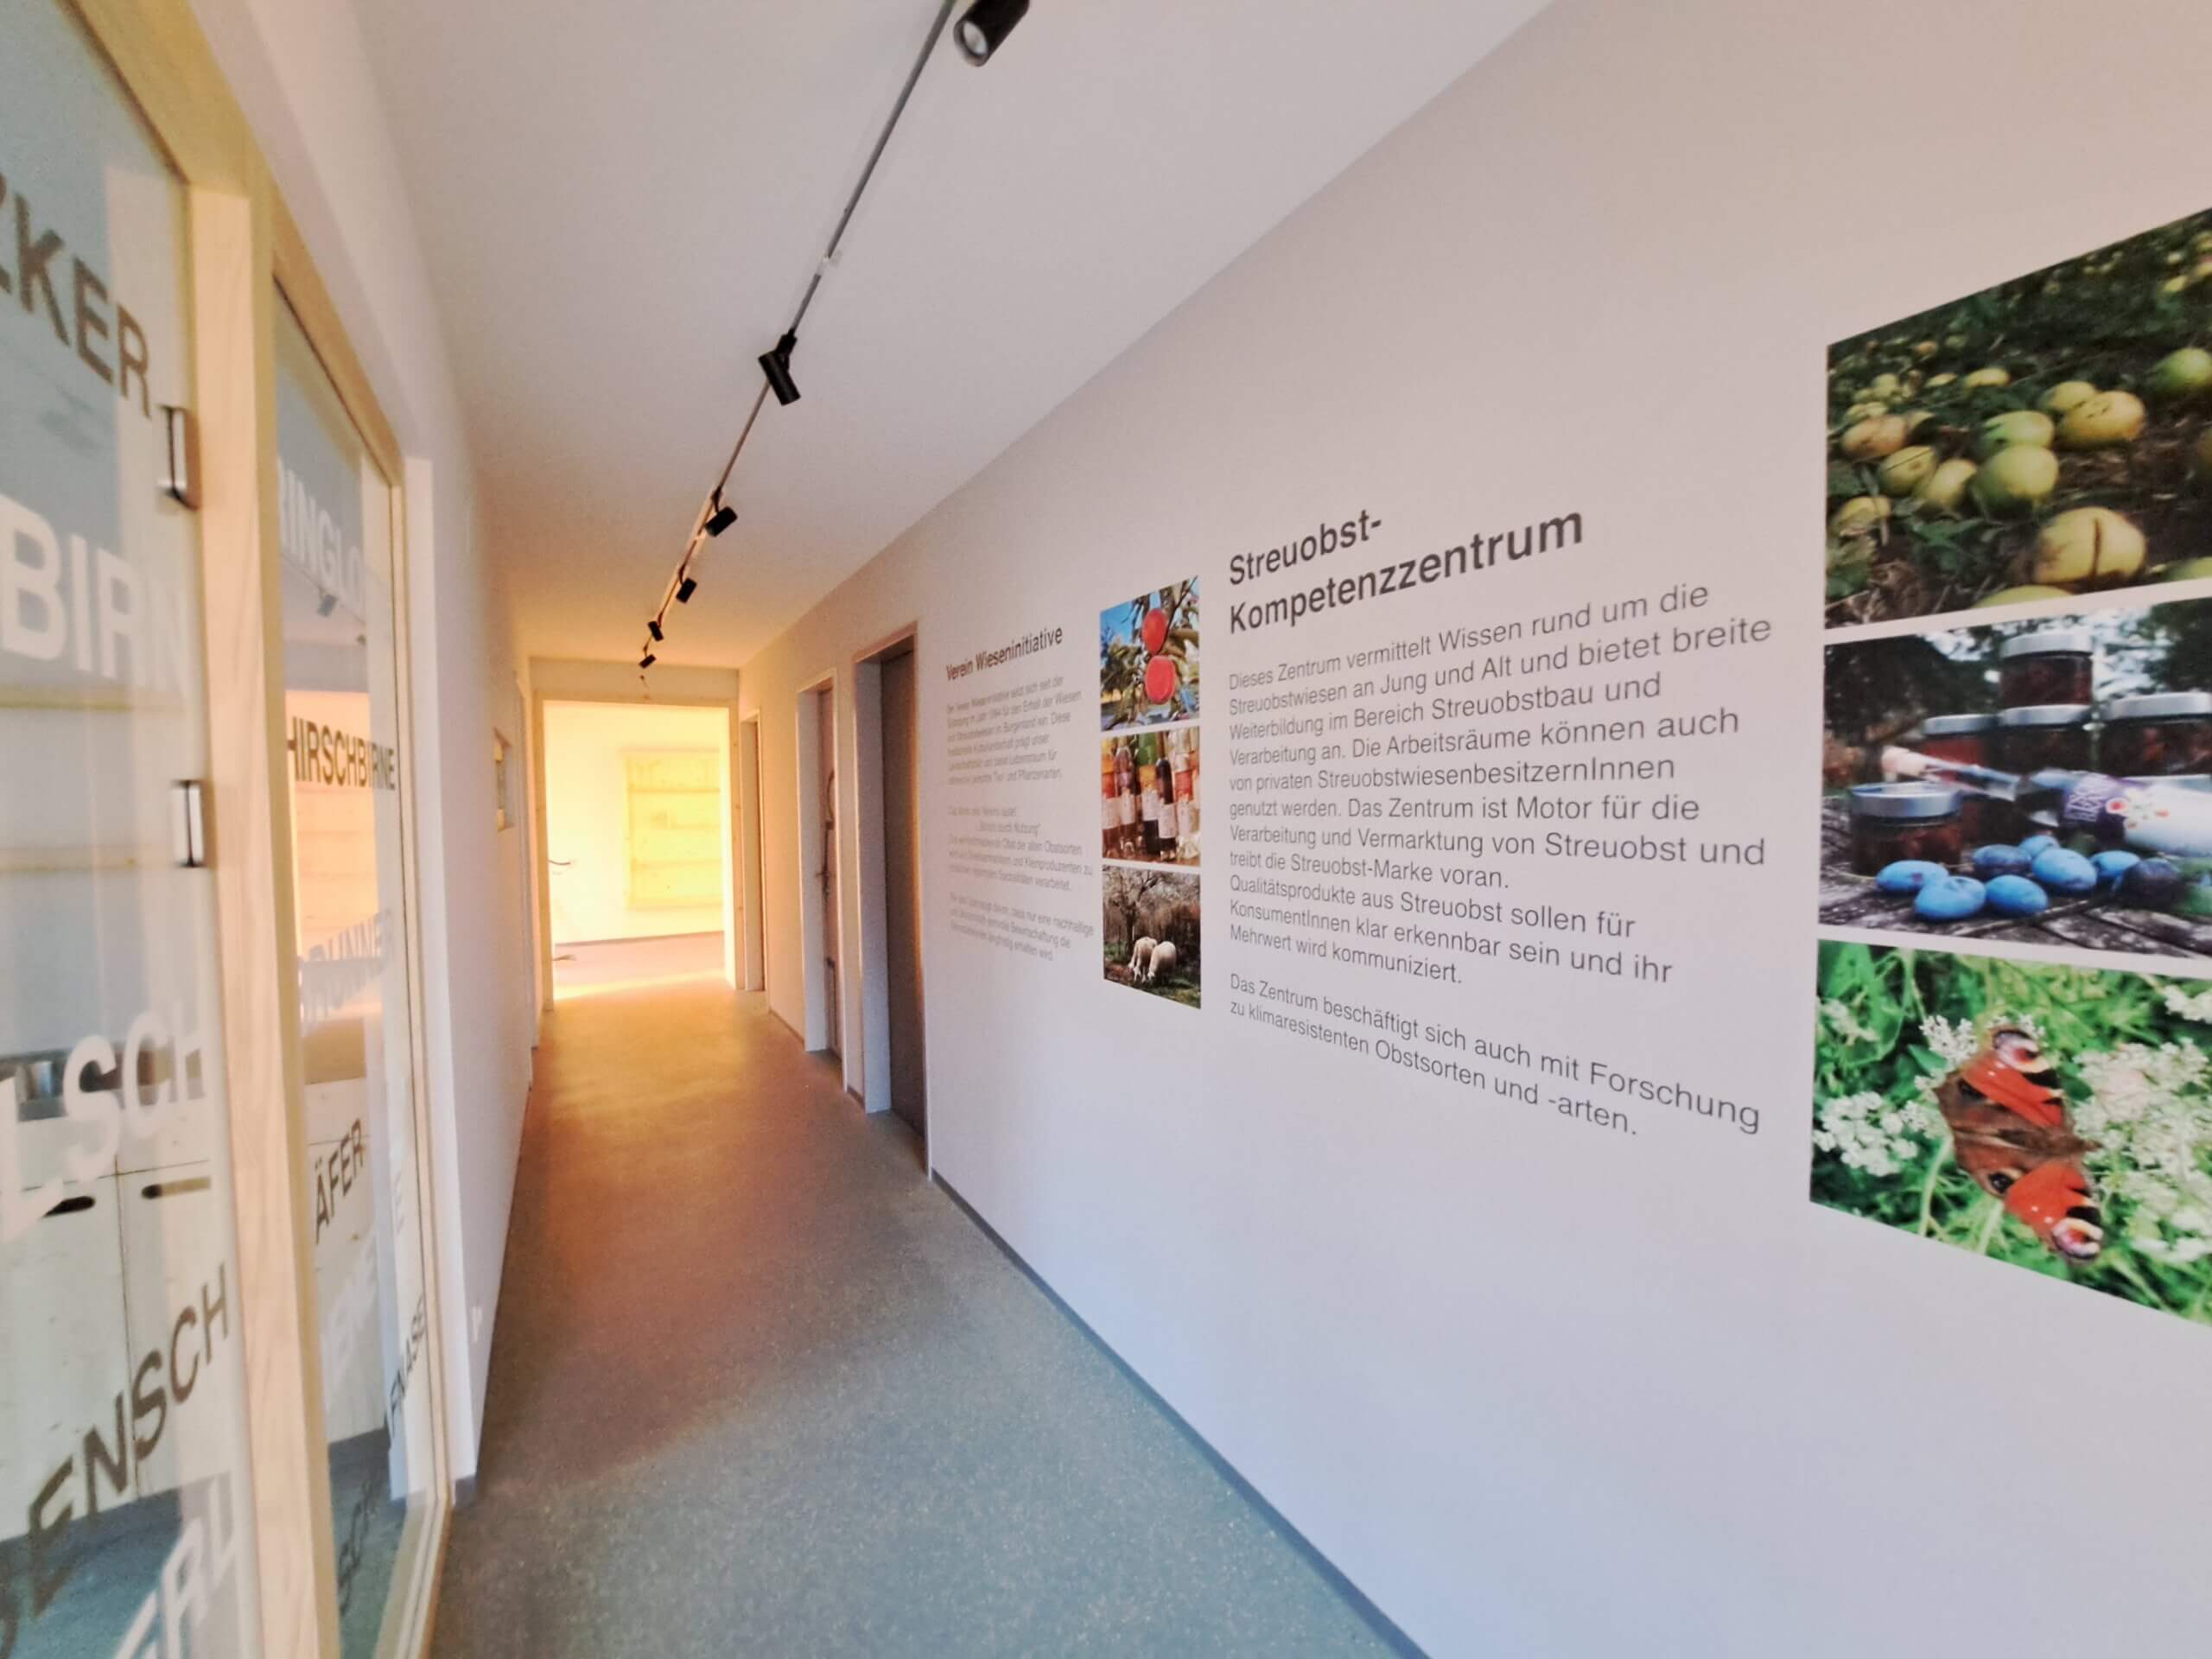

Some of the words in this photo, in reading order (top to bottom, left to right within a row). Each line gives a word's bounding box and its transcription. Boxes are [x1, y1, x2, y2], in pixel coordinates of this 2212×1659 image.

[0, 169, 152, 421] KER
[1229, 508, 1383, 587] Streuobst-
[1230, 511, 1584, 636] Kompetenzzentrum
[946, 659, 974, 681] Verein
[976, 626, 1064, 671] Wieseninitiative
[1228, 670, 1274, 691] Dieses
[1277, 657, 1342, 683] Zentrum
[1345, 635, 1432, 670] vermittelt
[1437, 621, 1522, 653] Wissen
[1531, 601, 1592, 637] rund
[1601, 597, 1649, 624] um
[1658, 582, 1710, 614] die
[1229, 684, 1348, 716] Streuobstwiesen
[1352, 680, 1375, 699] an
[1379, 672, 1427, 696] Jung
[1434, 659, 1475, 687] und
[1480, 654, 1513, 681] Alt
[1520, 644, 1568, 676] und
[1578, 631, 1662, 667] bietet
[1672, 617, 1772, 654] breite
[1228, 717, 1325, 741] Weiterbildung
[1328, 711, 1349, 731] im
[1353, 701, 1424, 728] Bereich
[1431, 684, 1594, 721] Streuobstbau
[1604, 670, 1662, 702] und
[1229, 746, 1317, 766] Verarbeitung
[1351, 737, 1382, 759] Die
[1385, 728, 1532, 756] Arbeitsräume
[1541, 719, 1645, 747] können
[1656, 706, 1739, 739] auch
[288, 715, 395, 791] HIRSCHBIRNE
[1229, 777, 1253, 791] von
[1255, 773, 1313, 795] privaten
[1317, 755, 1675, 790] StreuobstwiesenbesitzernInnen
[1229, 800, 1278, 821] genutzt
[1347, 797, 1383, 818] Das
[1388, 797, 1474, 819] Zentrum
[1482, 796, 1509, 820] ist
[1516, 794, 1593, 820] Motor
[1600, 793, 1643, 821] für
[1650, 793, 1700, 822] die
[1230, 824, 1317, 850] Verarbeitung
[1321, 827, 1352, 848] und
[1357, 827, 1484, 859] Vermarktung
[1491, 836, 1535, 855] von
[1544, 831, 1688, 863] Streuobst
[1699, 836, 1765, 867] und
[1229, 850, 1262, 868] treibt
[1264, 852, 1287, 871] die
[1290, 852, 1433, 883] Streuobst-Marke
[1439, 867, 1510, 889] voran.
[1230, 874, 1356, 906] Qualitätsprodukte
[1361, 892, 1395, 911] aus
[1400, 891, 1503, 924] Streuobst
[1510, 905, 1586, 934] sollen
[1595, 910, 1637, 938] für
[1230, 898, 1351, 934] KonsumentInnen
[1356, 916, 1389, 940] klar
[1393, 923, 1502, 957] erkennbar
[1508, 940, 1560, 967] sein
[1570, 950, 1623, 976] und
[1634, 953, 1674, 984] ihr
[1230, 923, 1292, 952] Mehrwert
[1295, 938, 1328, 958] wird
[1332, 941, 1463, 985] kommuniziert.
[1230, 972, 1256, 995] Das
[1258, 979, 1319, 1012] Zentrum
[1322, 995, 1420, 1042] beschäftigt
[1424, 1023, 1466, 1052] sich
[1473, 1038, 1532, 1069] auch
[1540, 1054, 1580, 1082] mit
[1589, 1060, 1760, 1136] Forschung
[1230, 1001, 1245, 1017] zu
[1248, 1002, 1370, 1056] klimaresistenten
[1375, 1039, 1486, 1090] Obstsorten
[1494, 1077, 1539, 1106] und
[1548, 1096, 1637, 1136] -arten.
[314, 1117, 364, 1245] ÄFER
